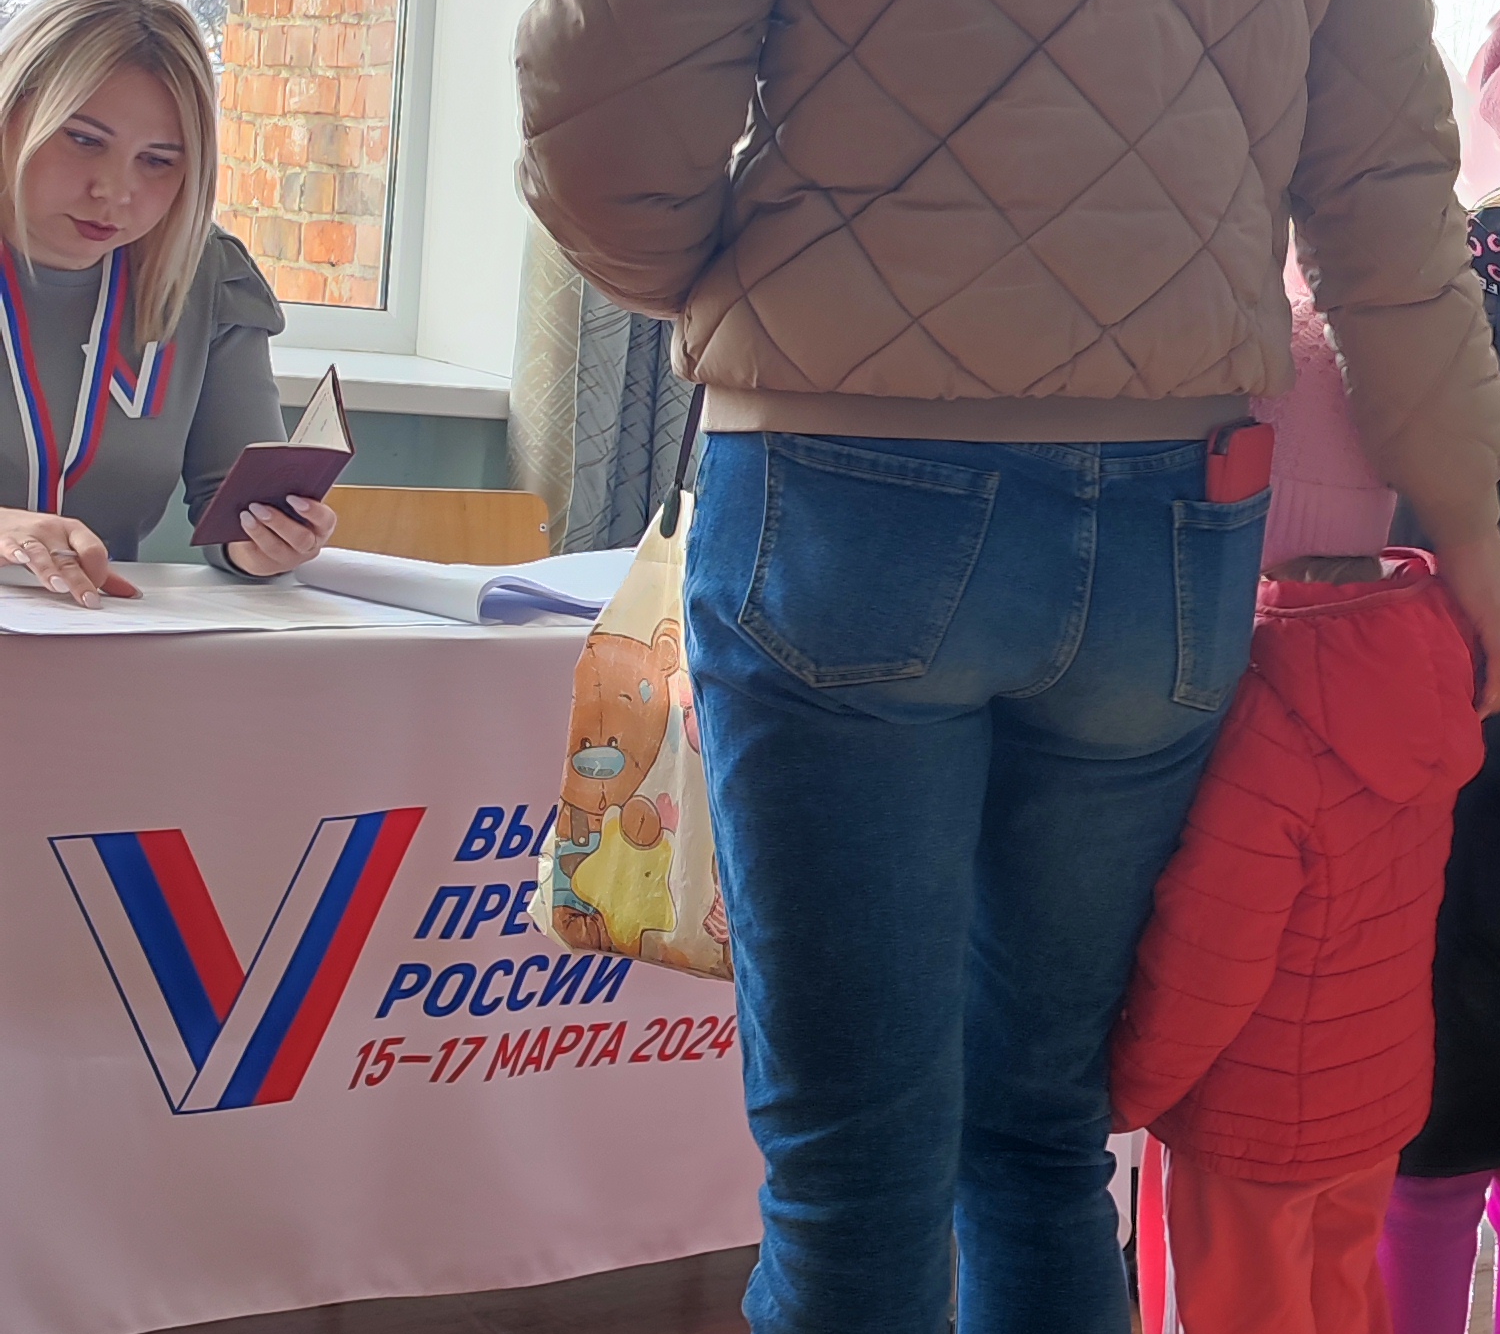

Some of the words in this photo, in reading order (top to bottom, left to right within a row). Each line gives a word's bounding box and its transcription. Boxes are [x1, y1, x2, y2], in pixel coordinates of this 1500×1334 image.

[375, 953, 634, 1019] РОССИИ
[484, 1021, 628, 1082] МАРТА
[629, 1014, 737, 1063] 2024
